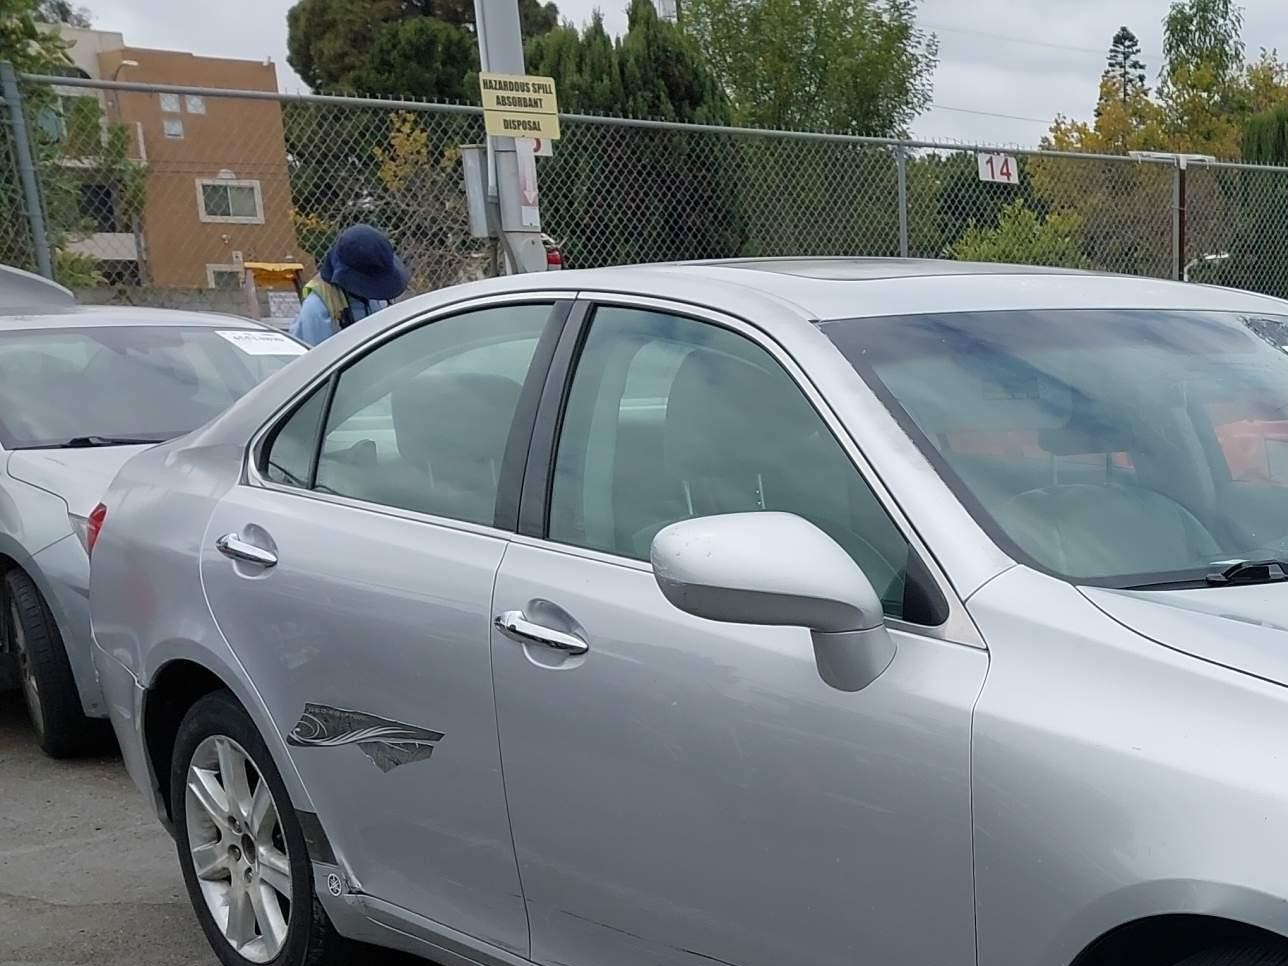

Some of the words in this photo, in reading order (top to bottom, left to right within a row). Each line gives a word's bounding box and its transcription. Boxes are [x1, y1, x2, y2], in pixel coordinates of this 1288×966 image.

[482, 79, 531, 93] HAZARDOUS
[531, 82, 553, 95] SPILL
[495, 95, 544, 109] ABSORBANT
[503, 119, 542, 132] DISPOSAL
[985, 155, 1012, 182] 14
